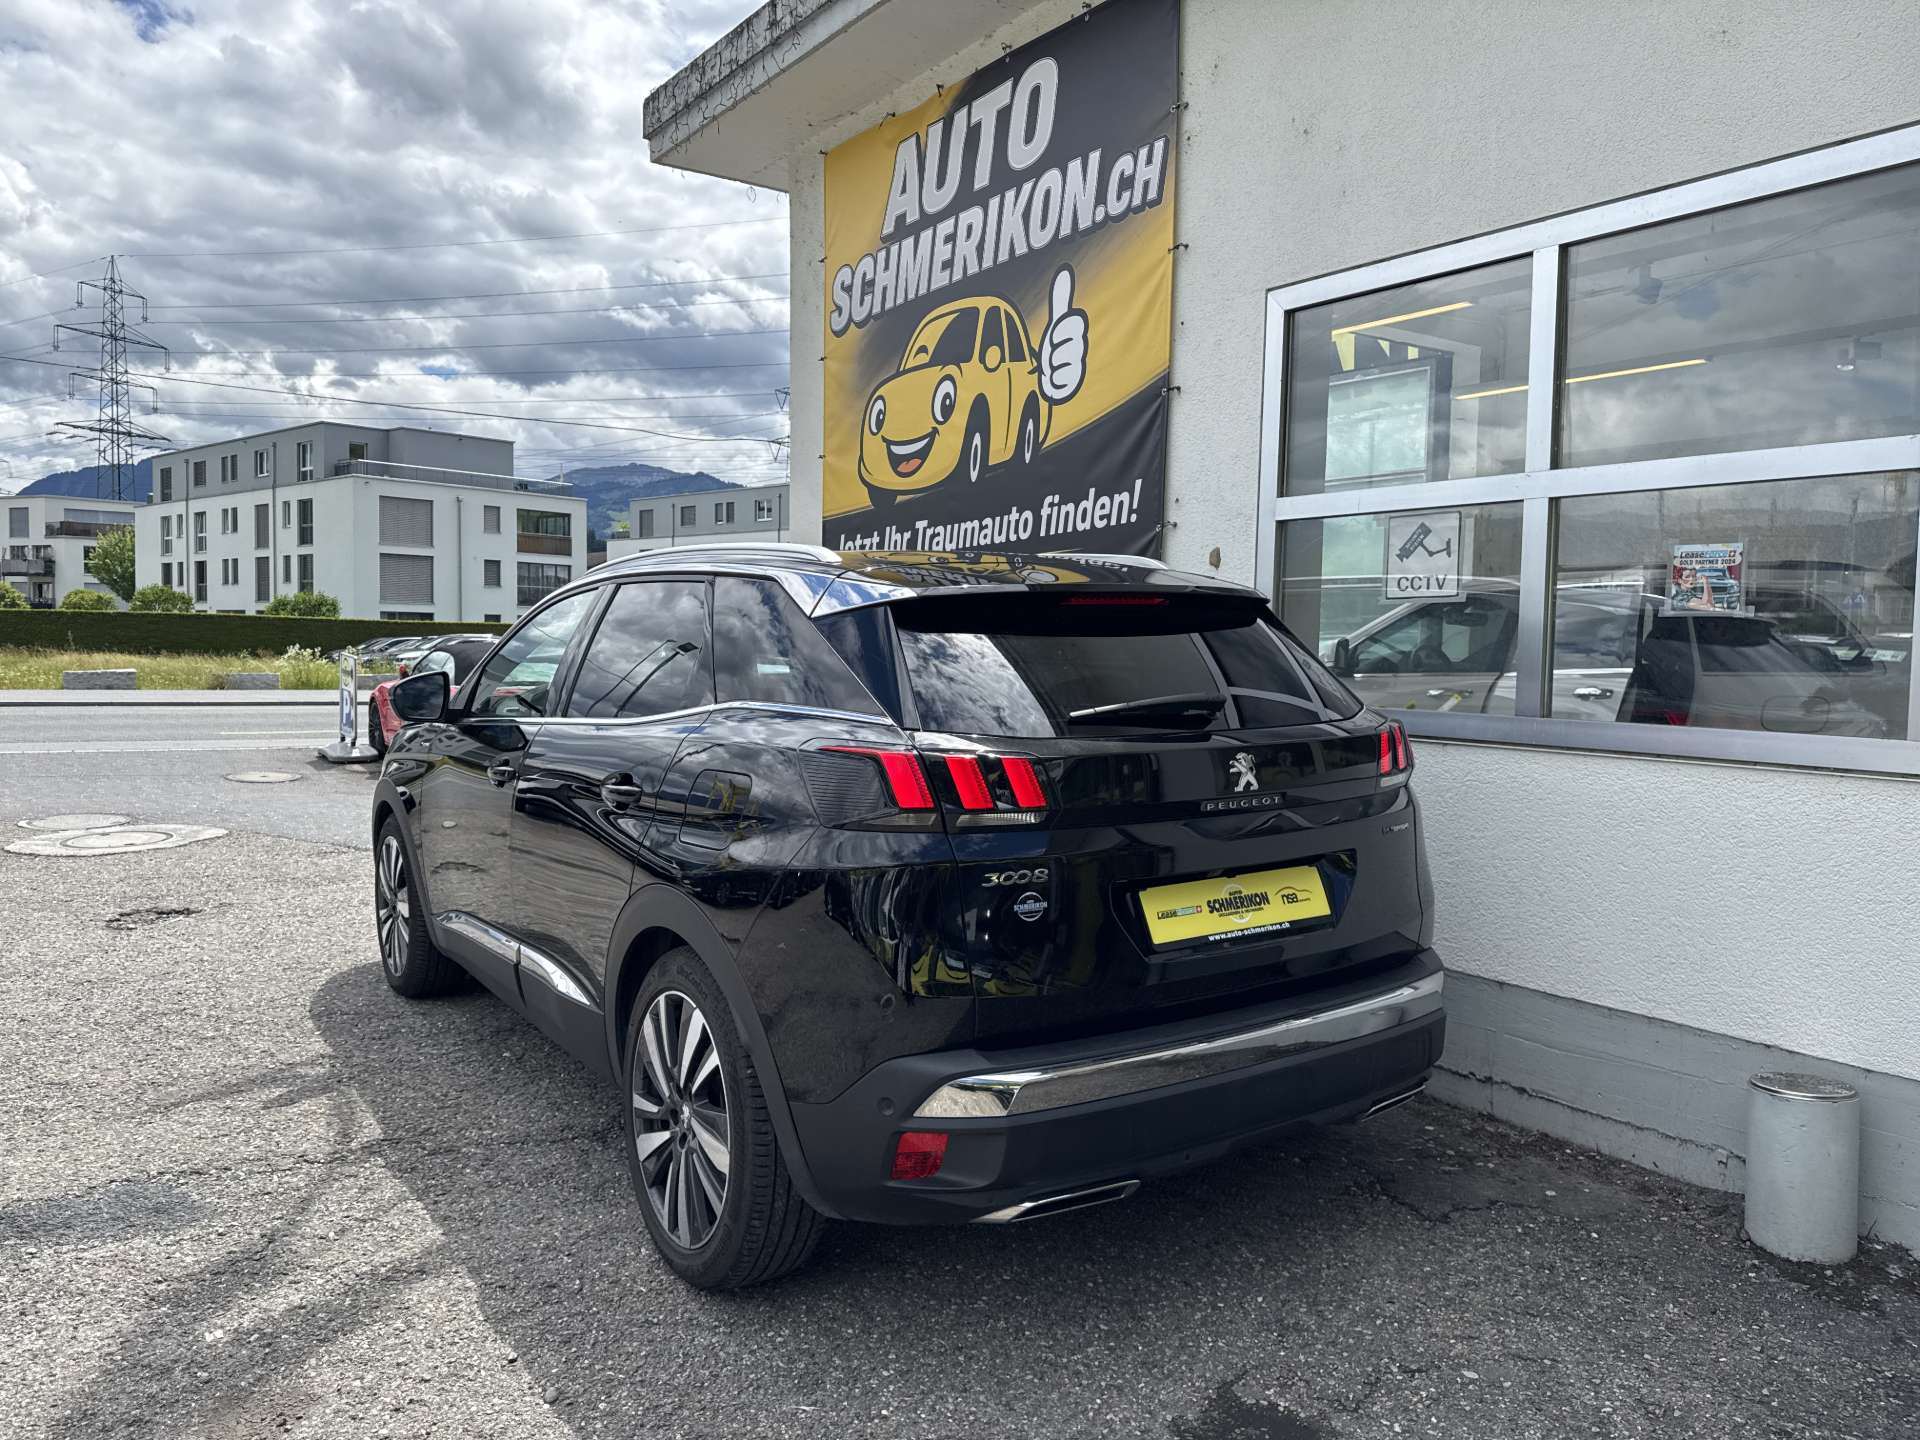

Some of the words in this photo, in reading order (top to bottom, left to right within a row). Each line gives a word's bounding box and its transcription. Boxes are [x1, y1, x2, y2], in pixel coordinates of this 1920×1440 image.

[880, 56, 1059, 241] AUTO
[830, 136, 1167, 335] SCHMERIKON.CH
[884, 525, 911, 551] Ihr
[915, 506, 1033, 551] Traumauto
[1040, 479, 1143, 537] finden!
[1397, 574, 1447, 592] CCTV
[1207, 796, 1279, 811] PEUGEOT
[981, 868, 1048, 887] 3008
[1206, 891, 1271, 914] SCHMERIKON
[1281, 892, 1298, 904] nsa
[1208, 922, 1290, 941] www.auto-schmerikon.ch
